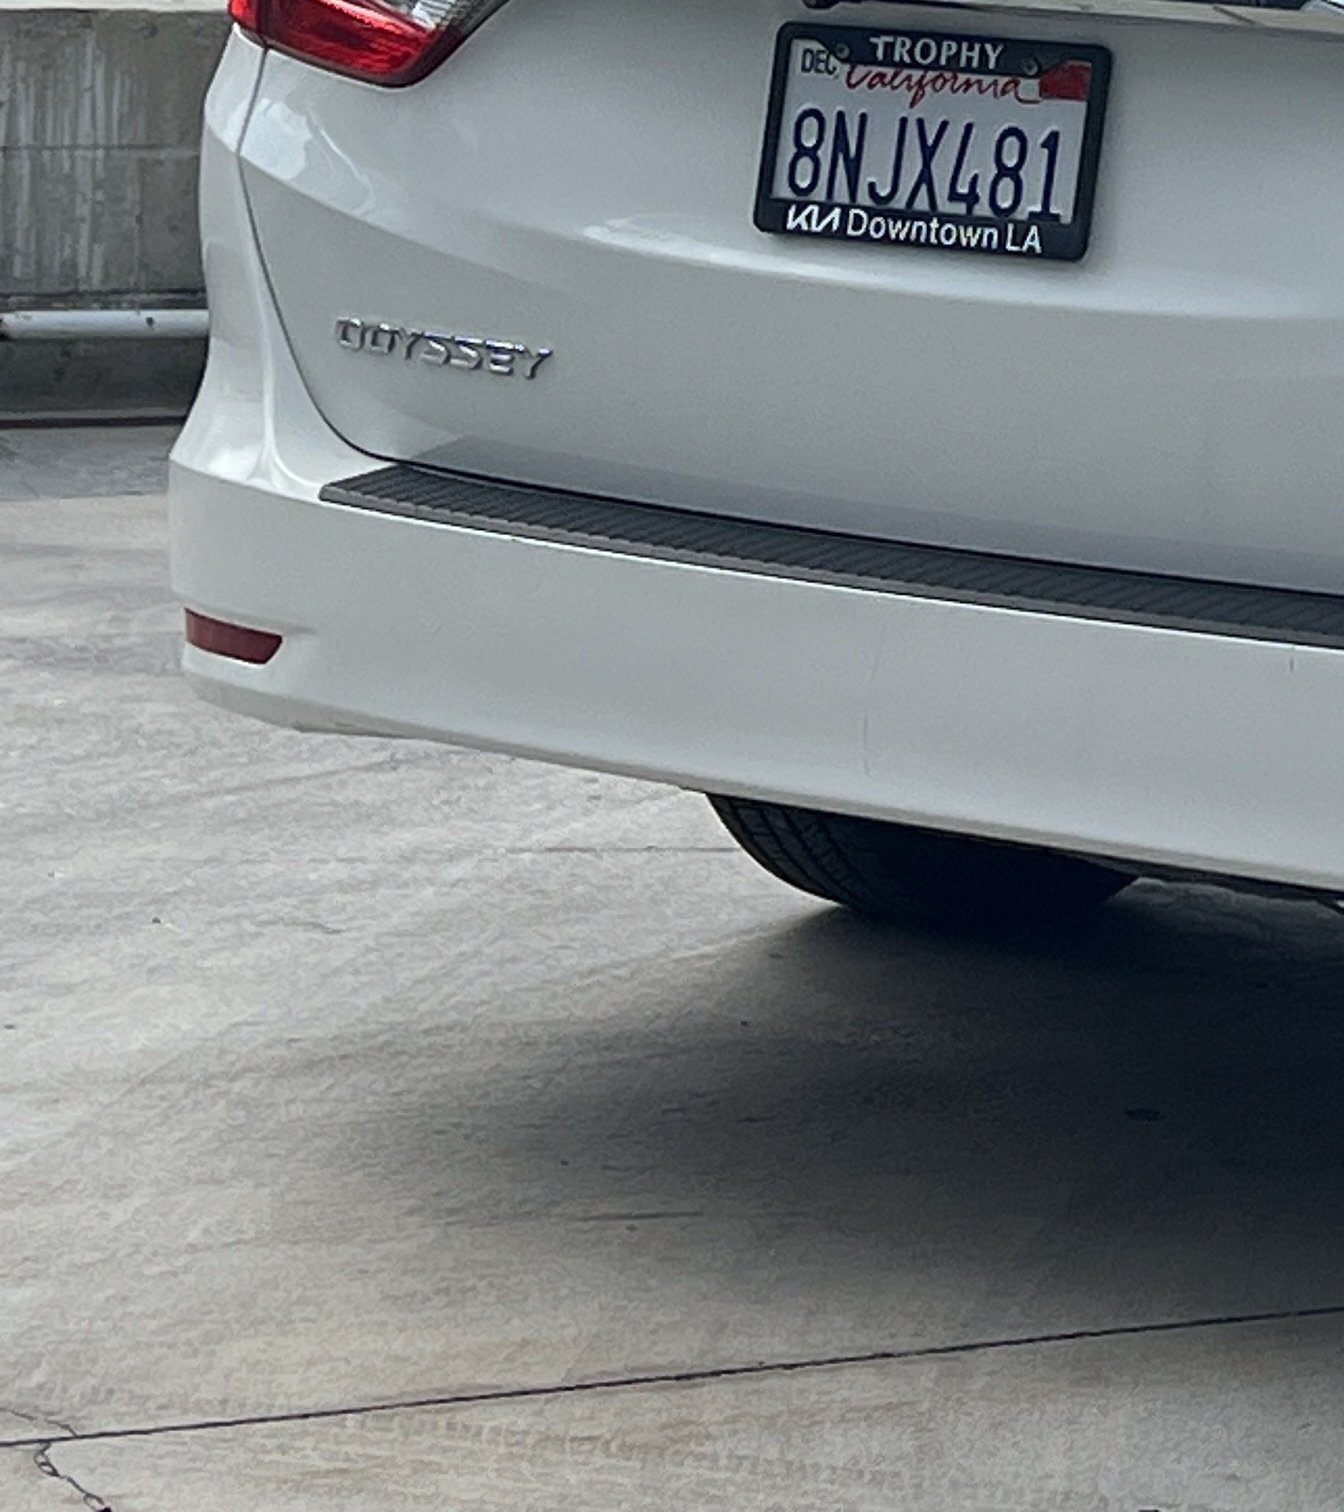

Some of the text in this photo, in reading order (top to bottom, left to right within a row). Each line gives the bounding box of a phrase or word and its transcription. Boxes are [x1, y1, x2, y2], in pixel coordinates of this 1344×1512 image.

[801, 48, 837, 75] DEC
[869, 36, 1005, 70] TROPHY
[845, 65, 1041, 109] California
[788, 107, 1062, 223] 8NJX481
[846, 208, 1000, 250] Downtown
[1005, 224, 1043, 254] LA
[335, 317, 554, 380] ODYSSEY
